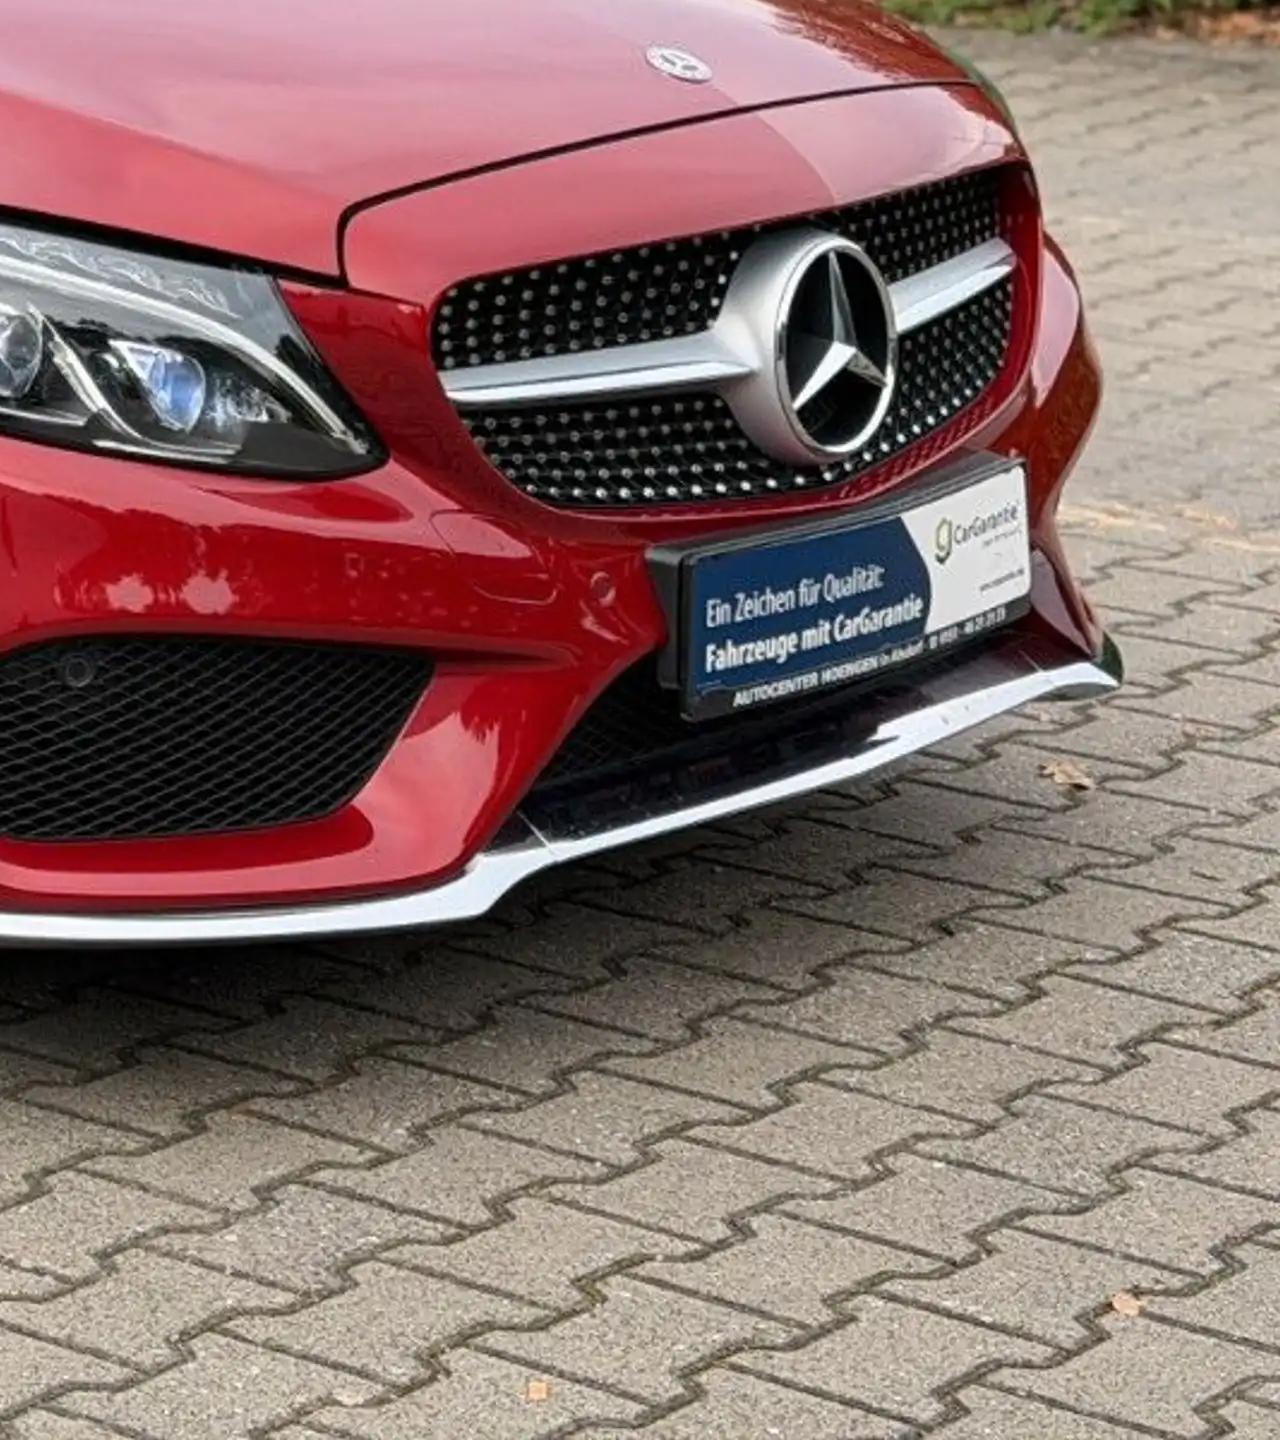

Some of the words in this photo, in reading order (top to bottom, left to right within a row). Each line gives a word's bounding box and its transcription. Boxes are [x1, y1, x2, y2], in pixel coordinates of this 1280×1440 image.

[954, 501, 1019, 545] CarGarantie
[706, 598, 731, 628] Ein
[734, 586, 795, 623] Zeichen
[798, 577, 821, 608] für
[823, 564, 885, 602] Qualität:
[705, 633, 798, 674] Fahrzeuge
[801, 619, 832, 651] mit
[833, 593, 924, 642] CarGarantie
[733, 671, 819, 707] AUTOCENTER
[821, 656, 879, 684] HOENGEN
